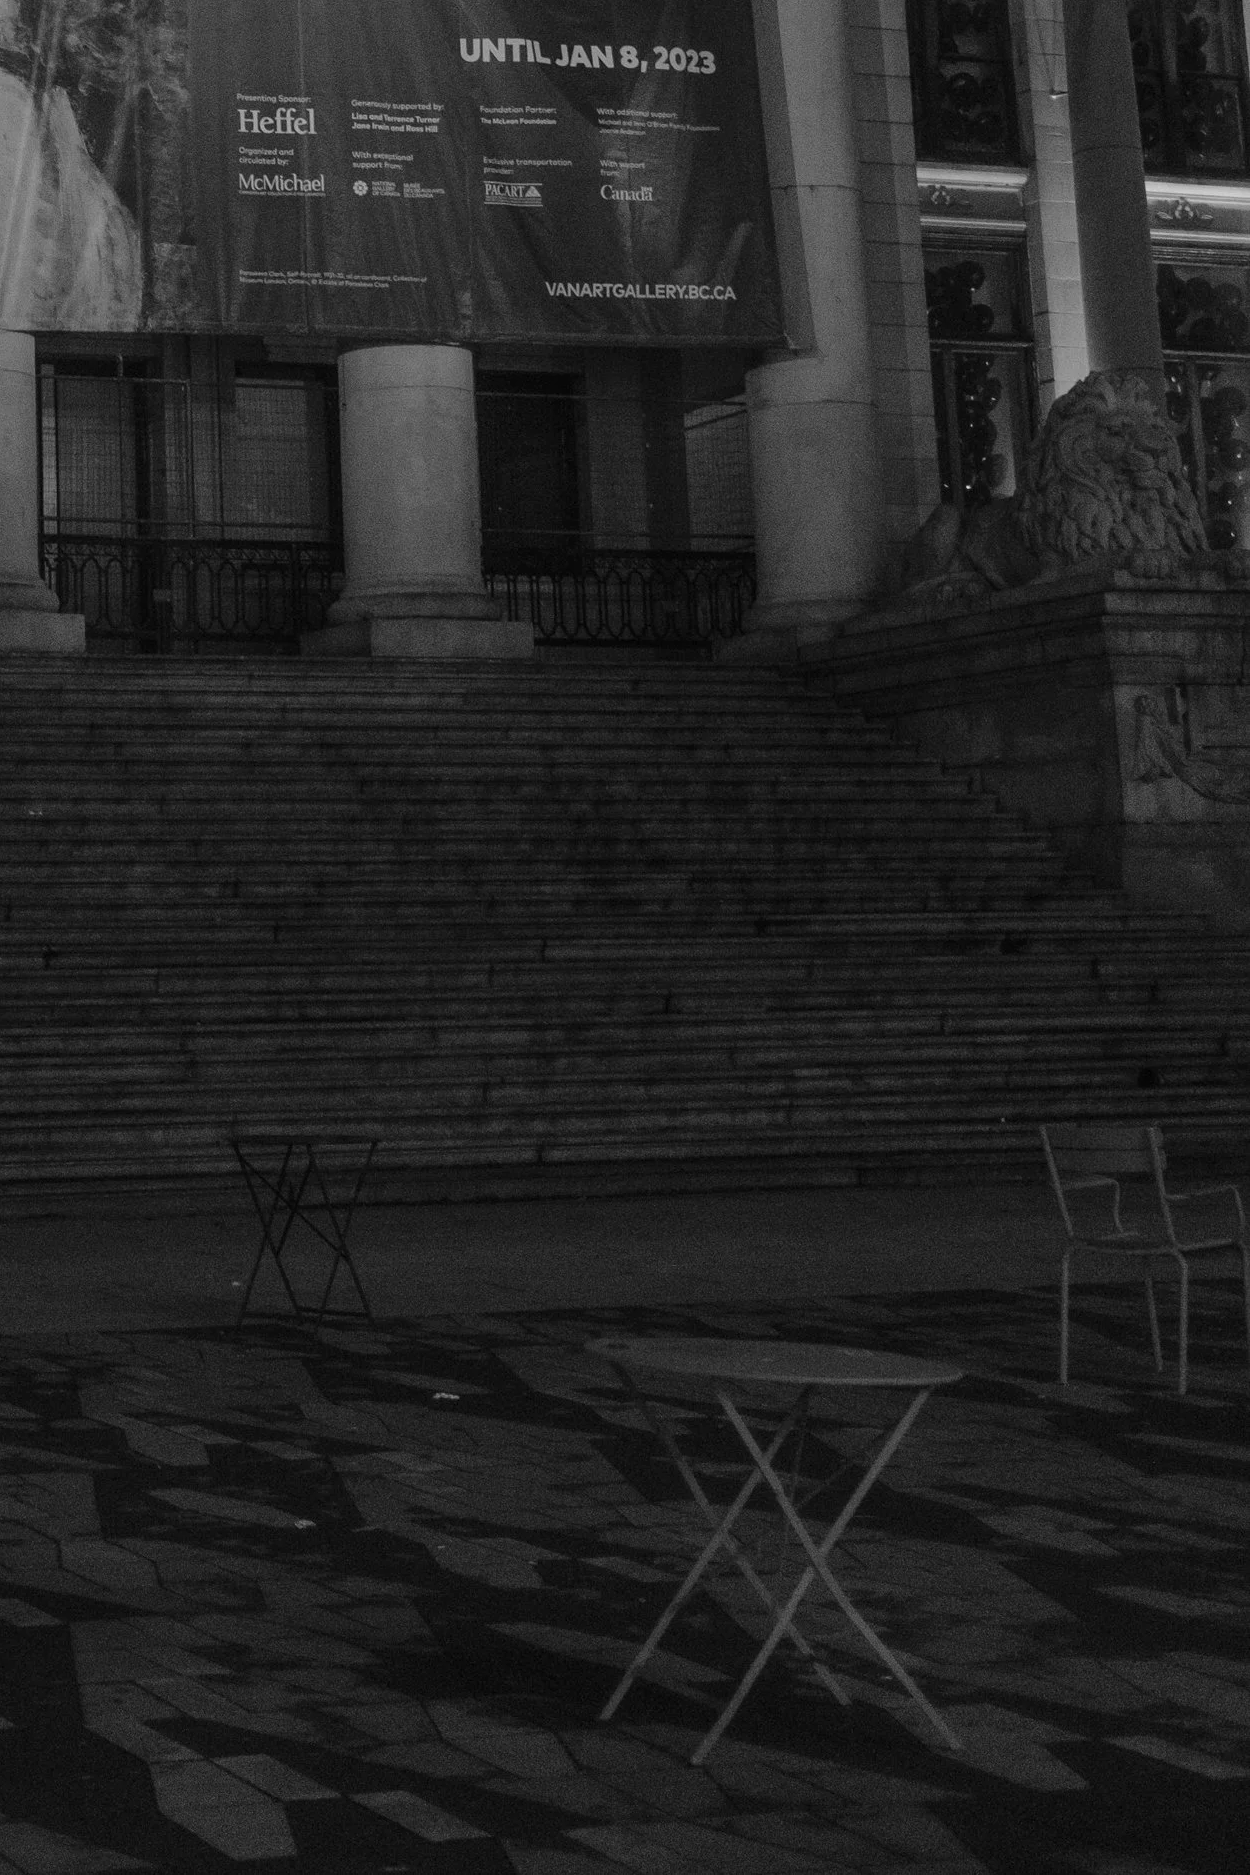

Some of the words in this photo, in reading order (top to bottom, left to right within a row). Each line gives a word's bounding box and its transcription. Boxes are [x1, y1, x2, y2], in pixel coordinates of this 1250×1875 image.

[459, 37, 551, 65] UNTIL
[555, 43, 614, 69] JAN
[619, 44, 648, 73] 8,
[652, 45, 716, 75] 2023
[236, 92, 277, 104] Presenting
[351, 99, 391, 110] Generously
[392, 103, 432, 111] supported
[479, 105, 525, 114] Foundation
[237, 107, 317, 135] Heffel
[369, 113, 383, 121] and
[390, 124, 405, 132] and
[238, 146, 277, 156] Organized
[278, 148, 294, 156] and
[351, 151, 372, 159] With
[238, 156, 276, 165] circulated
[352, 161, 383, 170] support
[483, 156, 515, 165] Exclusive
[515, 158, 573, 168] transportation
[238, 172, 325, 192] McMichael
[485, 183, 525, 198] PACART
[600, 184, 653, 202] Canada
[545, 281, 737, 300] VANARTGALLERY.BC.CA
